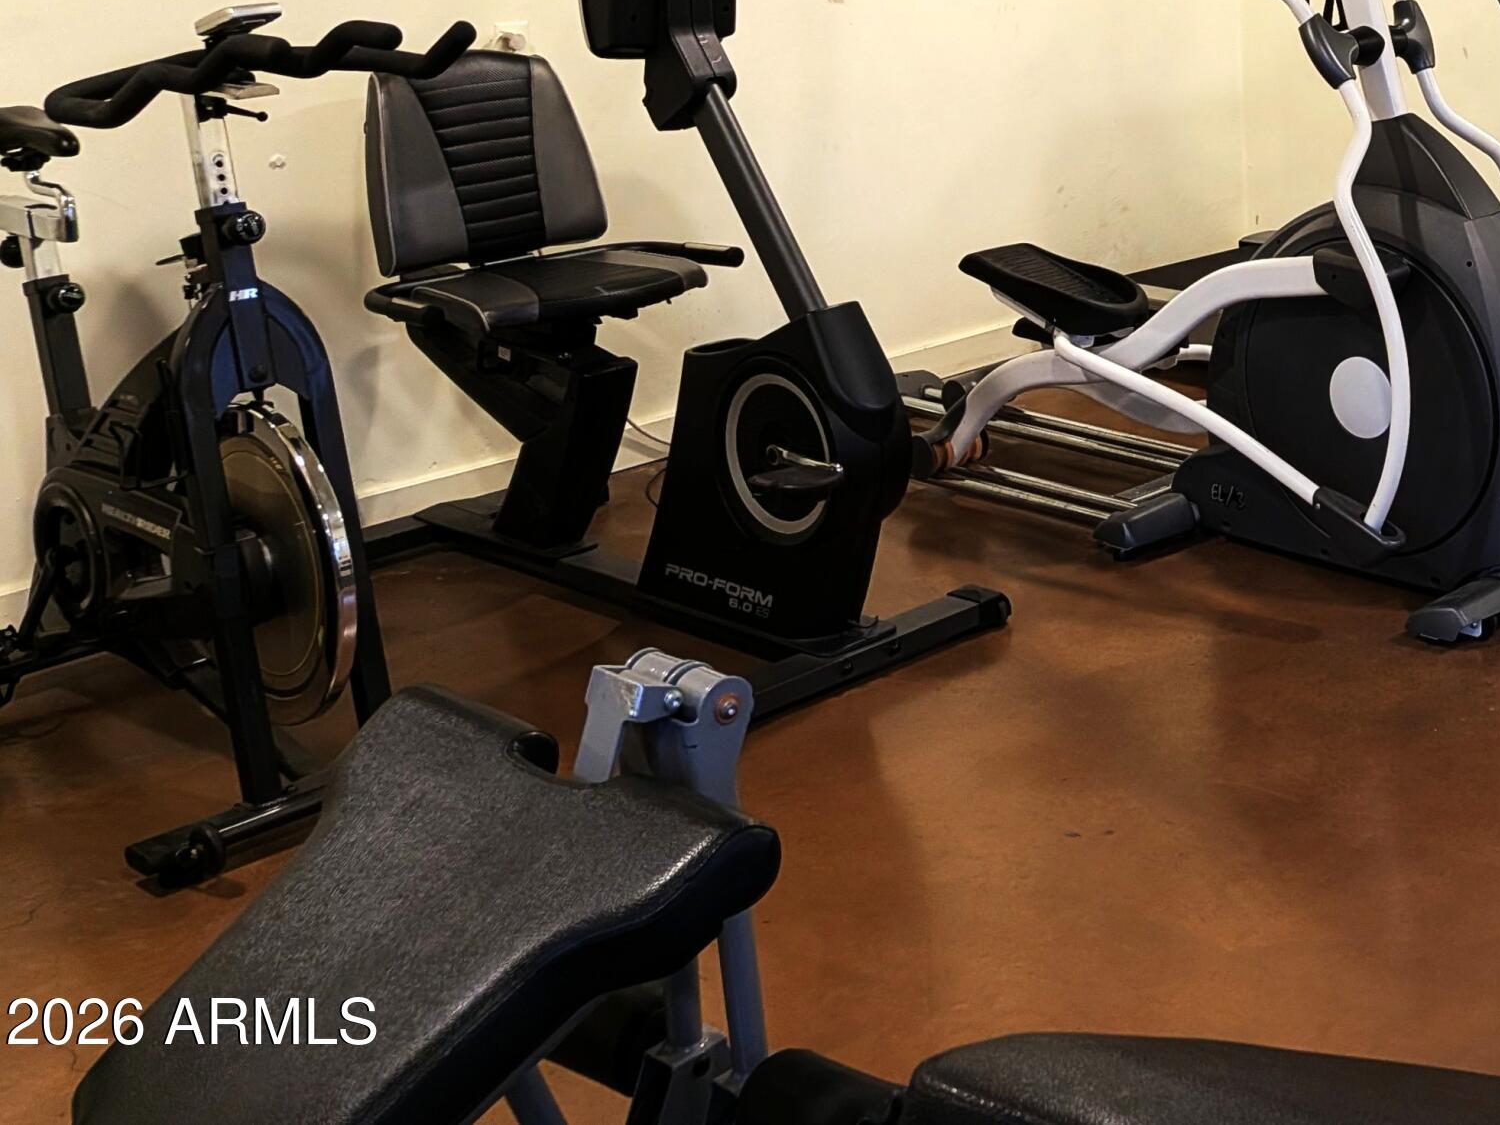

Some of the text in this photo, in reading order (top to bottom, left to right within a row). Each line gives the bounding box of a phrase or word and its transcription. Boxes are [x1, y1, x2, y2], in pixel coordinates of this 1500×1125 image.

[229, 288, 258, 302] HR
[664, 563, 773, 608] PRO-FORM
[728, 597, 753, 613] 6.0
